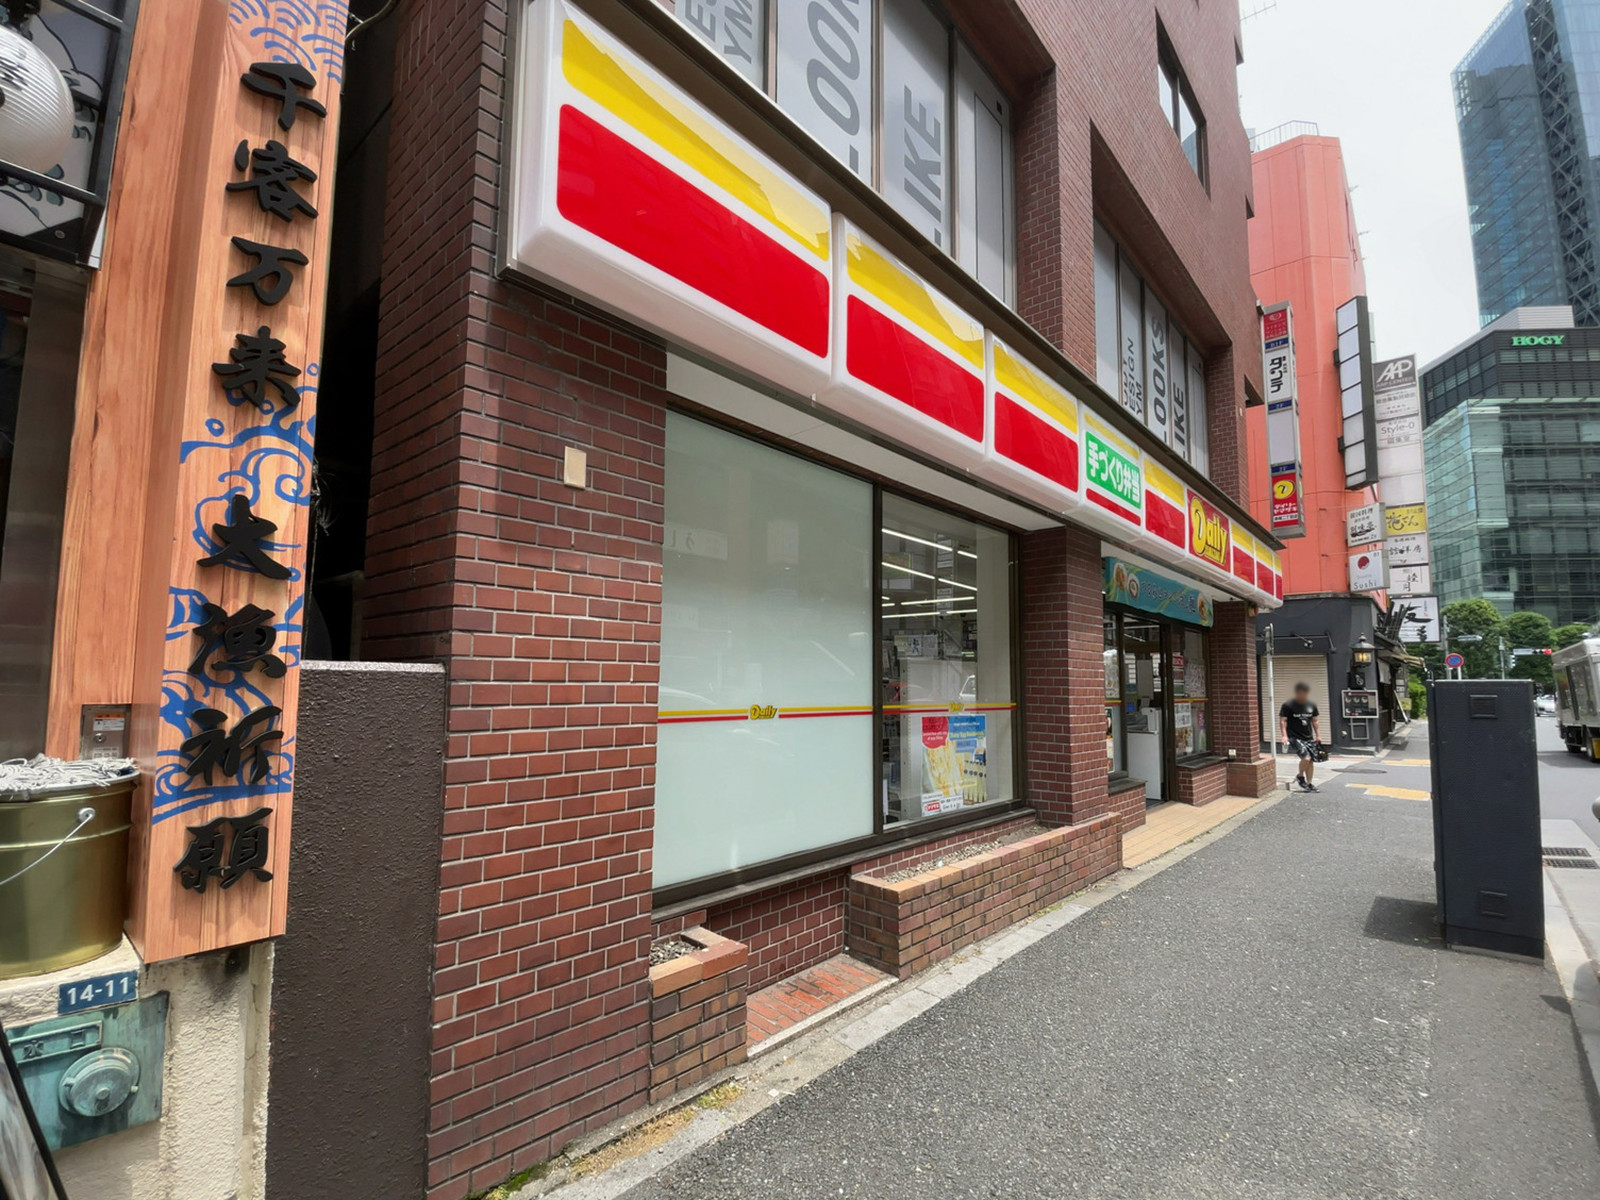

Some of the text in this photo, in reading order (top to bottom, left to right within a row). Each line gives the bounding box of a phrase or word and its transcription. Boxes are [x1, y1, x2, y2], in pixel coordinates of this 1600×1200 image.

[806, 0, 860, 174] OO
[904, 84, 942, 247] IKE
[212, 62, 327, 408] 千客万来
[1376, 359, 1413, 383] AAP
[1512, 335, 1564, 346] HOGY
[1151, 316, 1167, 443] OOKS
[1269, 356, 1286, 393] ダンテ
[1172, 382, 1185, 458] IKE
[1088, 440, 1140, 503] 手づくり弁当
[1191, 496, 1228, 565] Daily
[1354, 580, 1377, 590] Sushi
[173, 495, 291, 893] 大漁祈願
[750, 704, 777, 720] Daily
[68, 976, 129, 1005] 14-11
